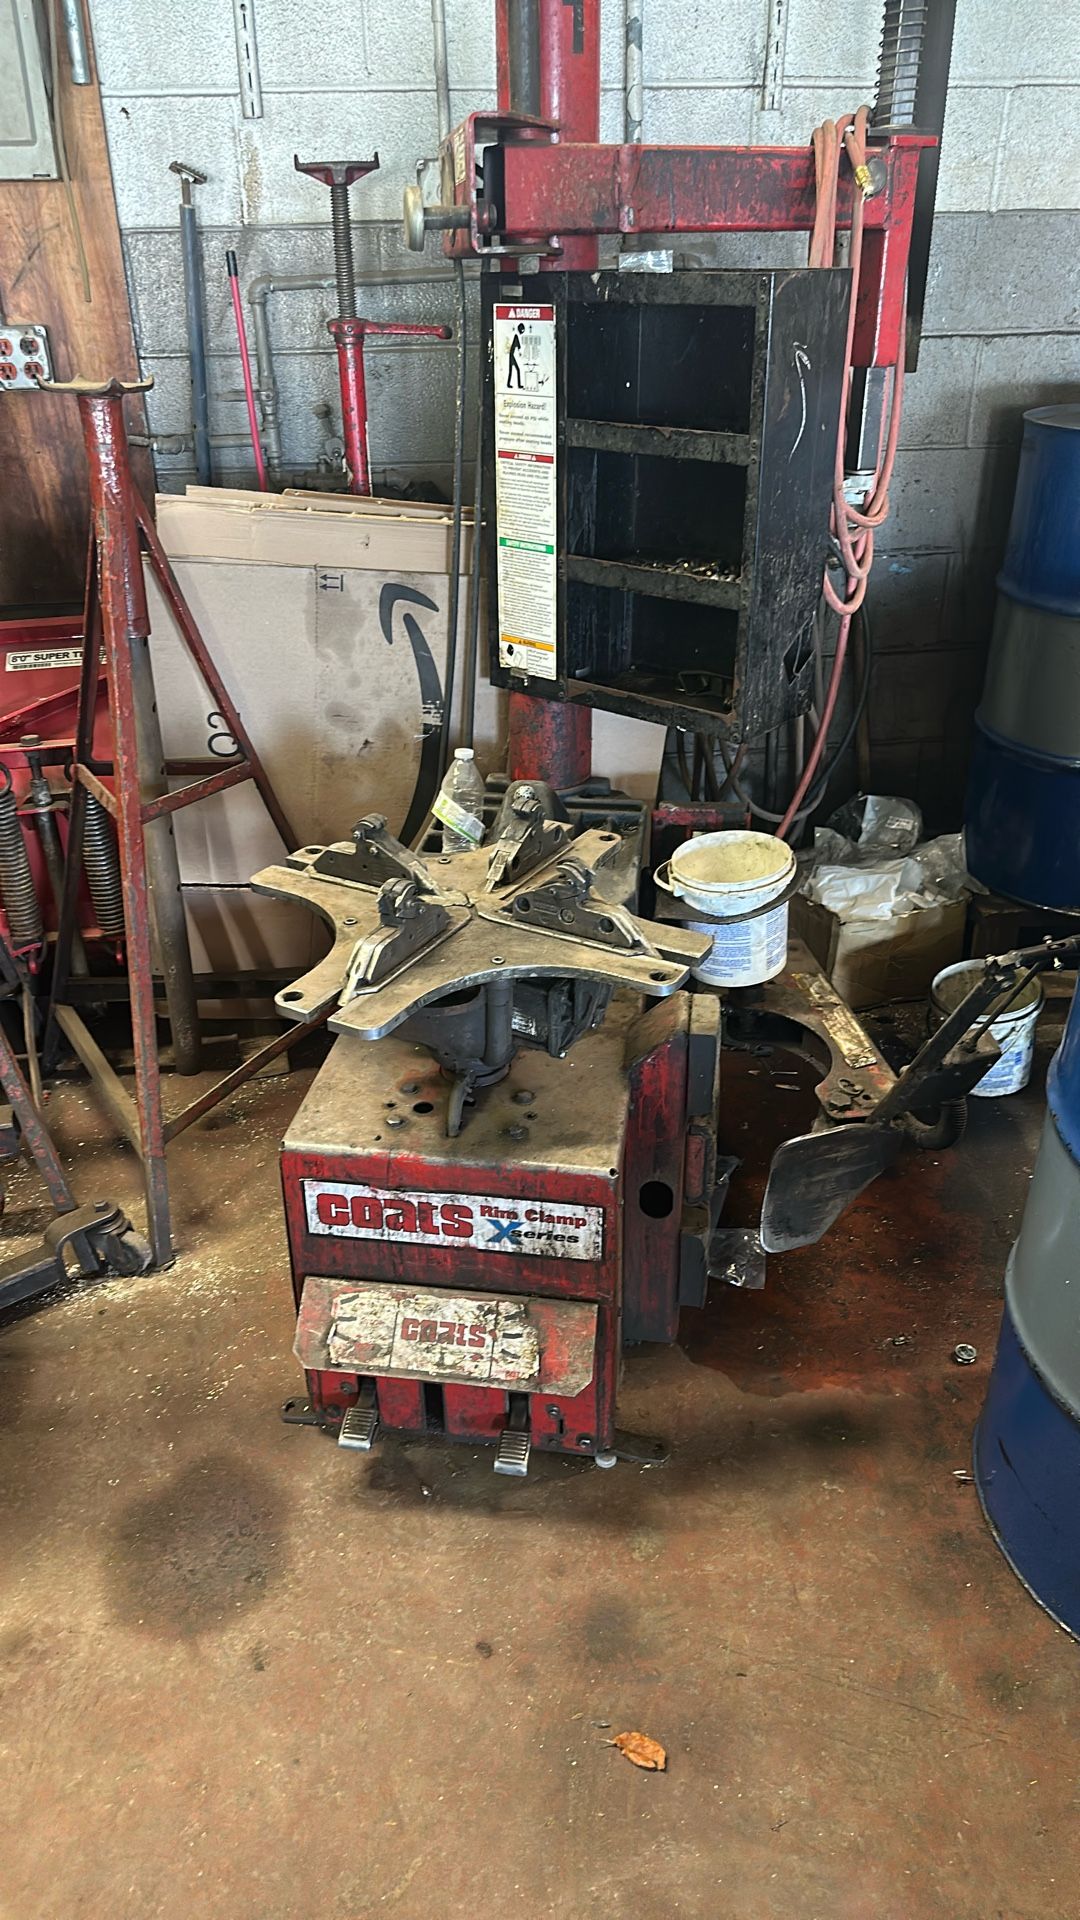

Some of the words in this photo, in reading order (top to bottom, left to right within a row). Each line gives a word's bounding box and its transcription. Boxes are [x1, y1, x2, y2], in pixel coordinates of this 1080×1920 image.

[516, 308, 541, 318] DANGER
[503, 400, 526, 409] Explosion
[34, 651, 70, 661] SUPER
[480, 1205, 519, 1220] Rim
[524, 1208, 587, 1229] Clamp
[511, 1229, 579, 1244] series
